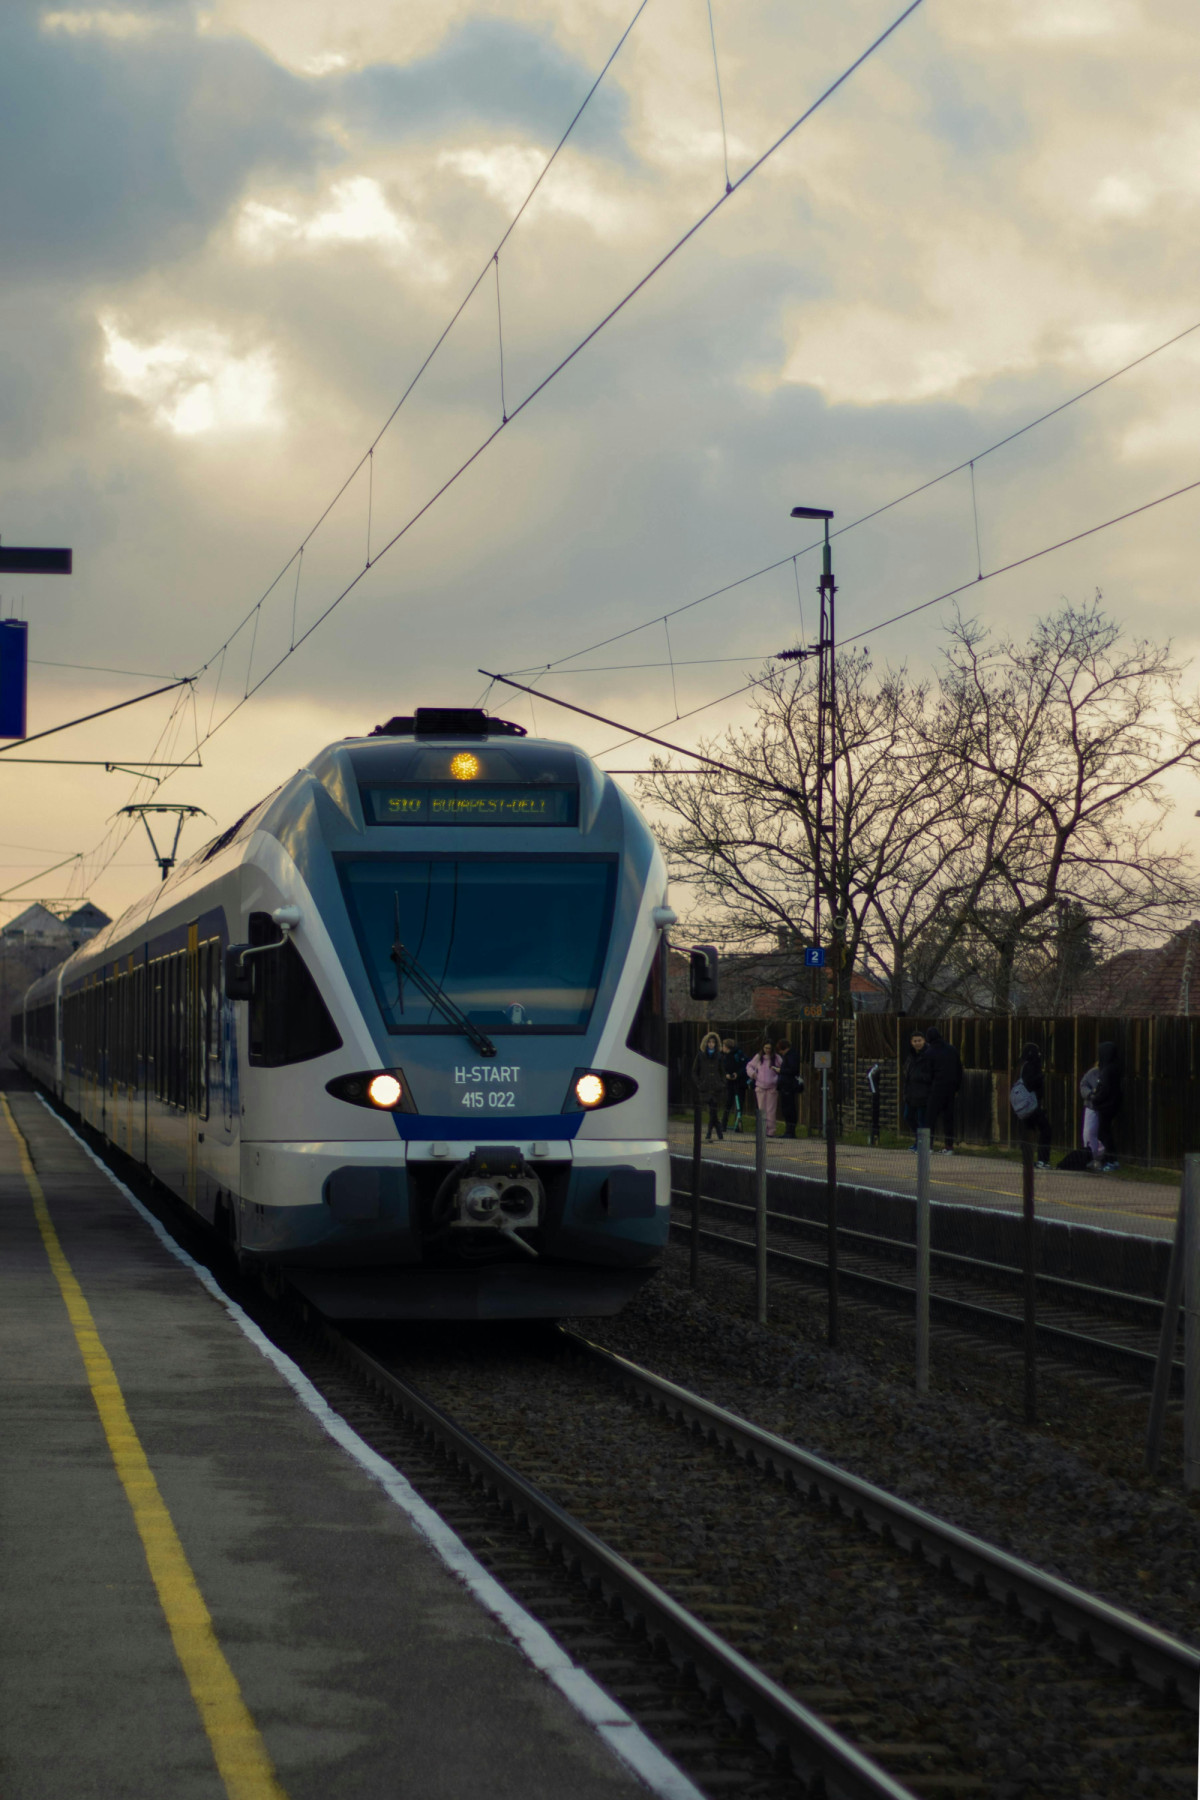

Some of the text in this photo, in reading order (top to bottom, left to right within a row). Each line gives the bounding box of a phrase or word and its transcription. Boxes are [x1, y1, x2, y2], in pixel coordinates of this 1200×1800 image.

[811, 950, 819, 961] 2
[455, 1066, 520, 1083] H-START
[461, 1092, 515, 1107] 415 022
